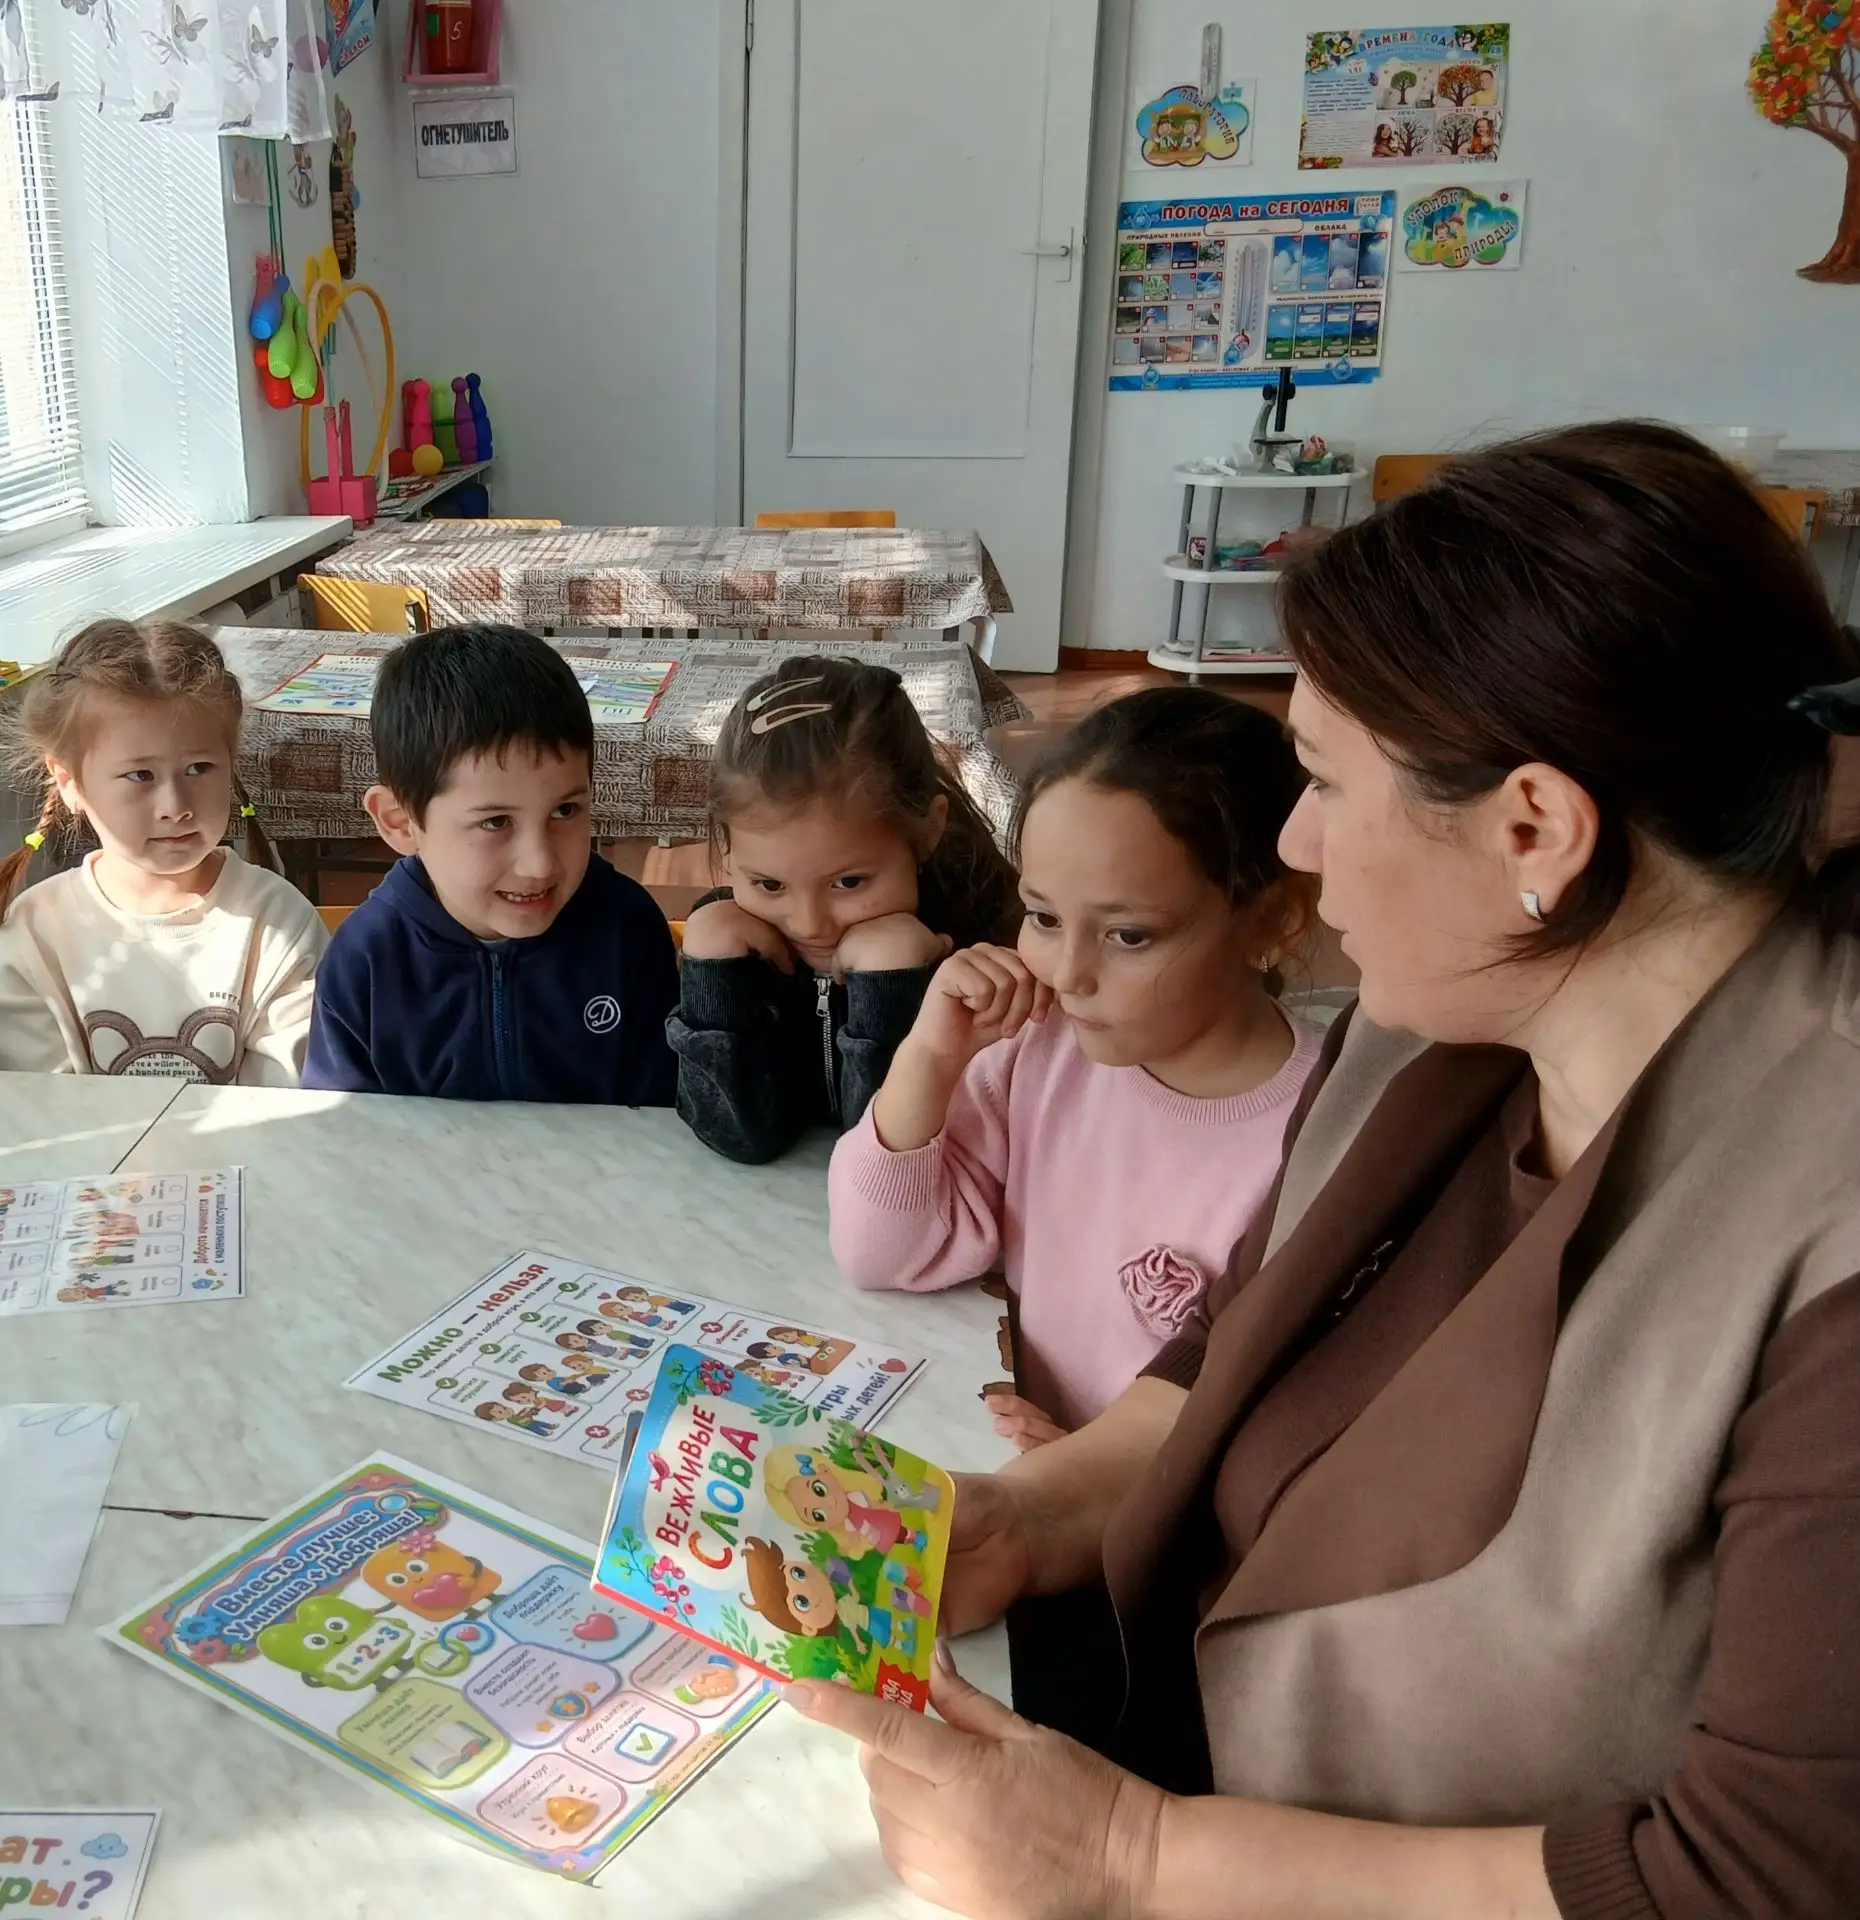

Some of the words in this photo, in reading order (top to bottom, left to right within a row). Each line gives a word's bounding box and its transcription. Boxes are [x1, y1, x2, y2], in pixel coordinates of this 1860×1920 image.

[450, 20, 462, 41] 5
[1359, 32, 1418, 52] ВРЕМЕНА
[1422, 33, 1455, 49] ГОДА
[421, 120, 509, 146] ОГНЕТУШИТЕЛЬ
[1162, 203, 1233, 221] ПОГОДА
[1239, 205, 1261, 217] на
[1267, 199, 1349, 217] СЕГОДНЯ
[1314, 223, 1347, 232] ОБЛАКА
[1454, 221, 1516, 260] ПРИРОДЫ
[377, 1327, 464, 1383] Можно
[476, 1263, 549, 1312] нельзя
[861, 1371, 892, 1405] детей!
[656, 1404, 716, 1549] ВЕЖЛИВЫЕ
[688, 1425, 760, 1571] СЛОВА
[213, 1554, 302, 1617] Вместе
[300, 1509, 379, 1563] лучше:
[223, 1579, 312, 1641] Умняша
[321, 1508, 424, 1575] Добряша!
[356, 1642, 381, 1661] 2
[379, 1623, 401, 1641] 3
[0, 1870, 113, 1912] ры?
